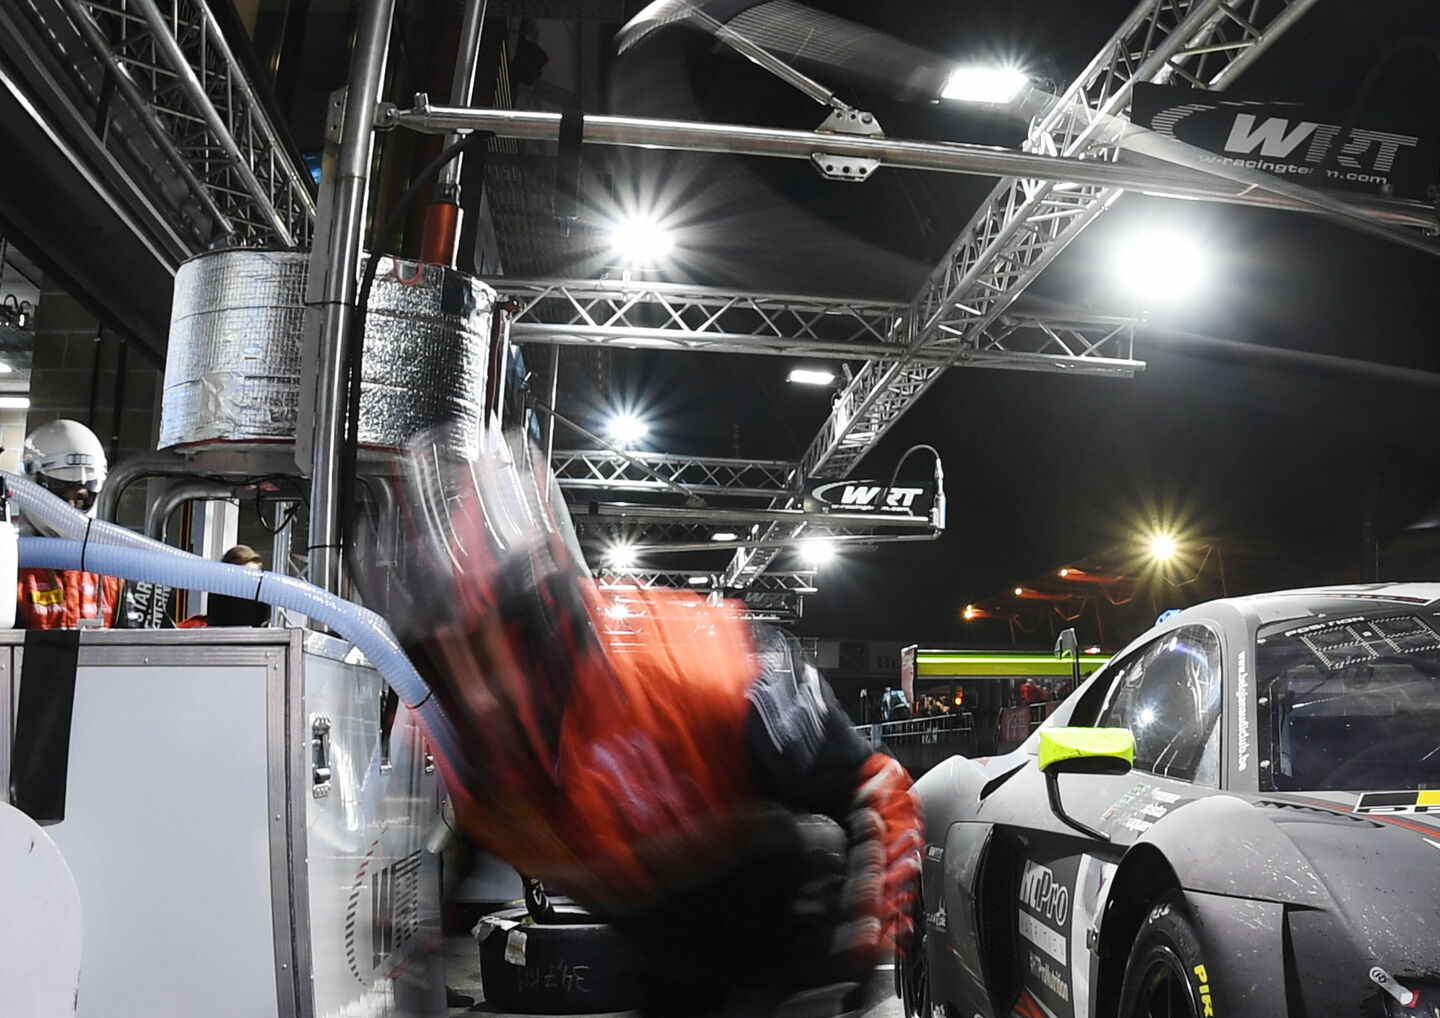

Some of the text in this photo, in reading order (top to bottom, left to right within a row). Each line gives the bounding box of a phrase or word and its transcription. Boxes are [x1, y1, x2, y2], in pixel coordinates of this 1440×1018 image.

[1224, 112, 1418, 173] WRT
[841, 486, 924, 506] WRT
[133, 580, 153, 622] STAR
